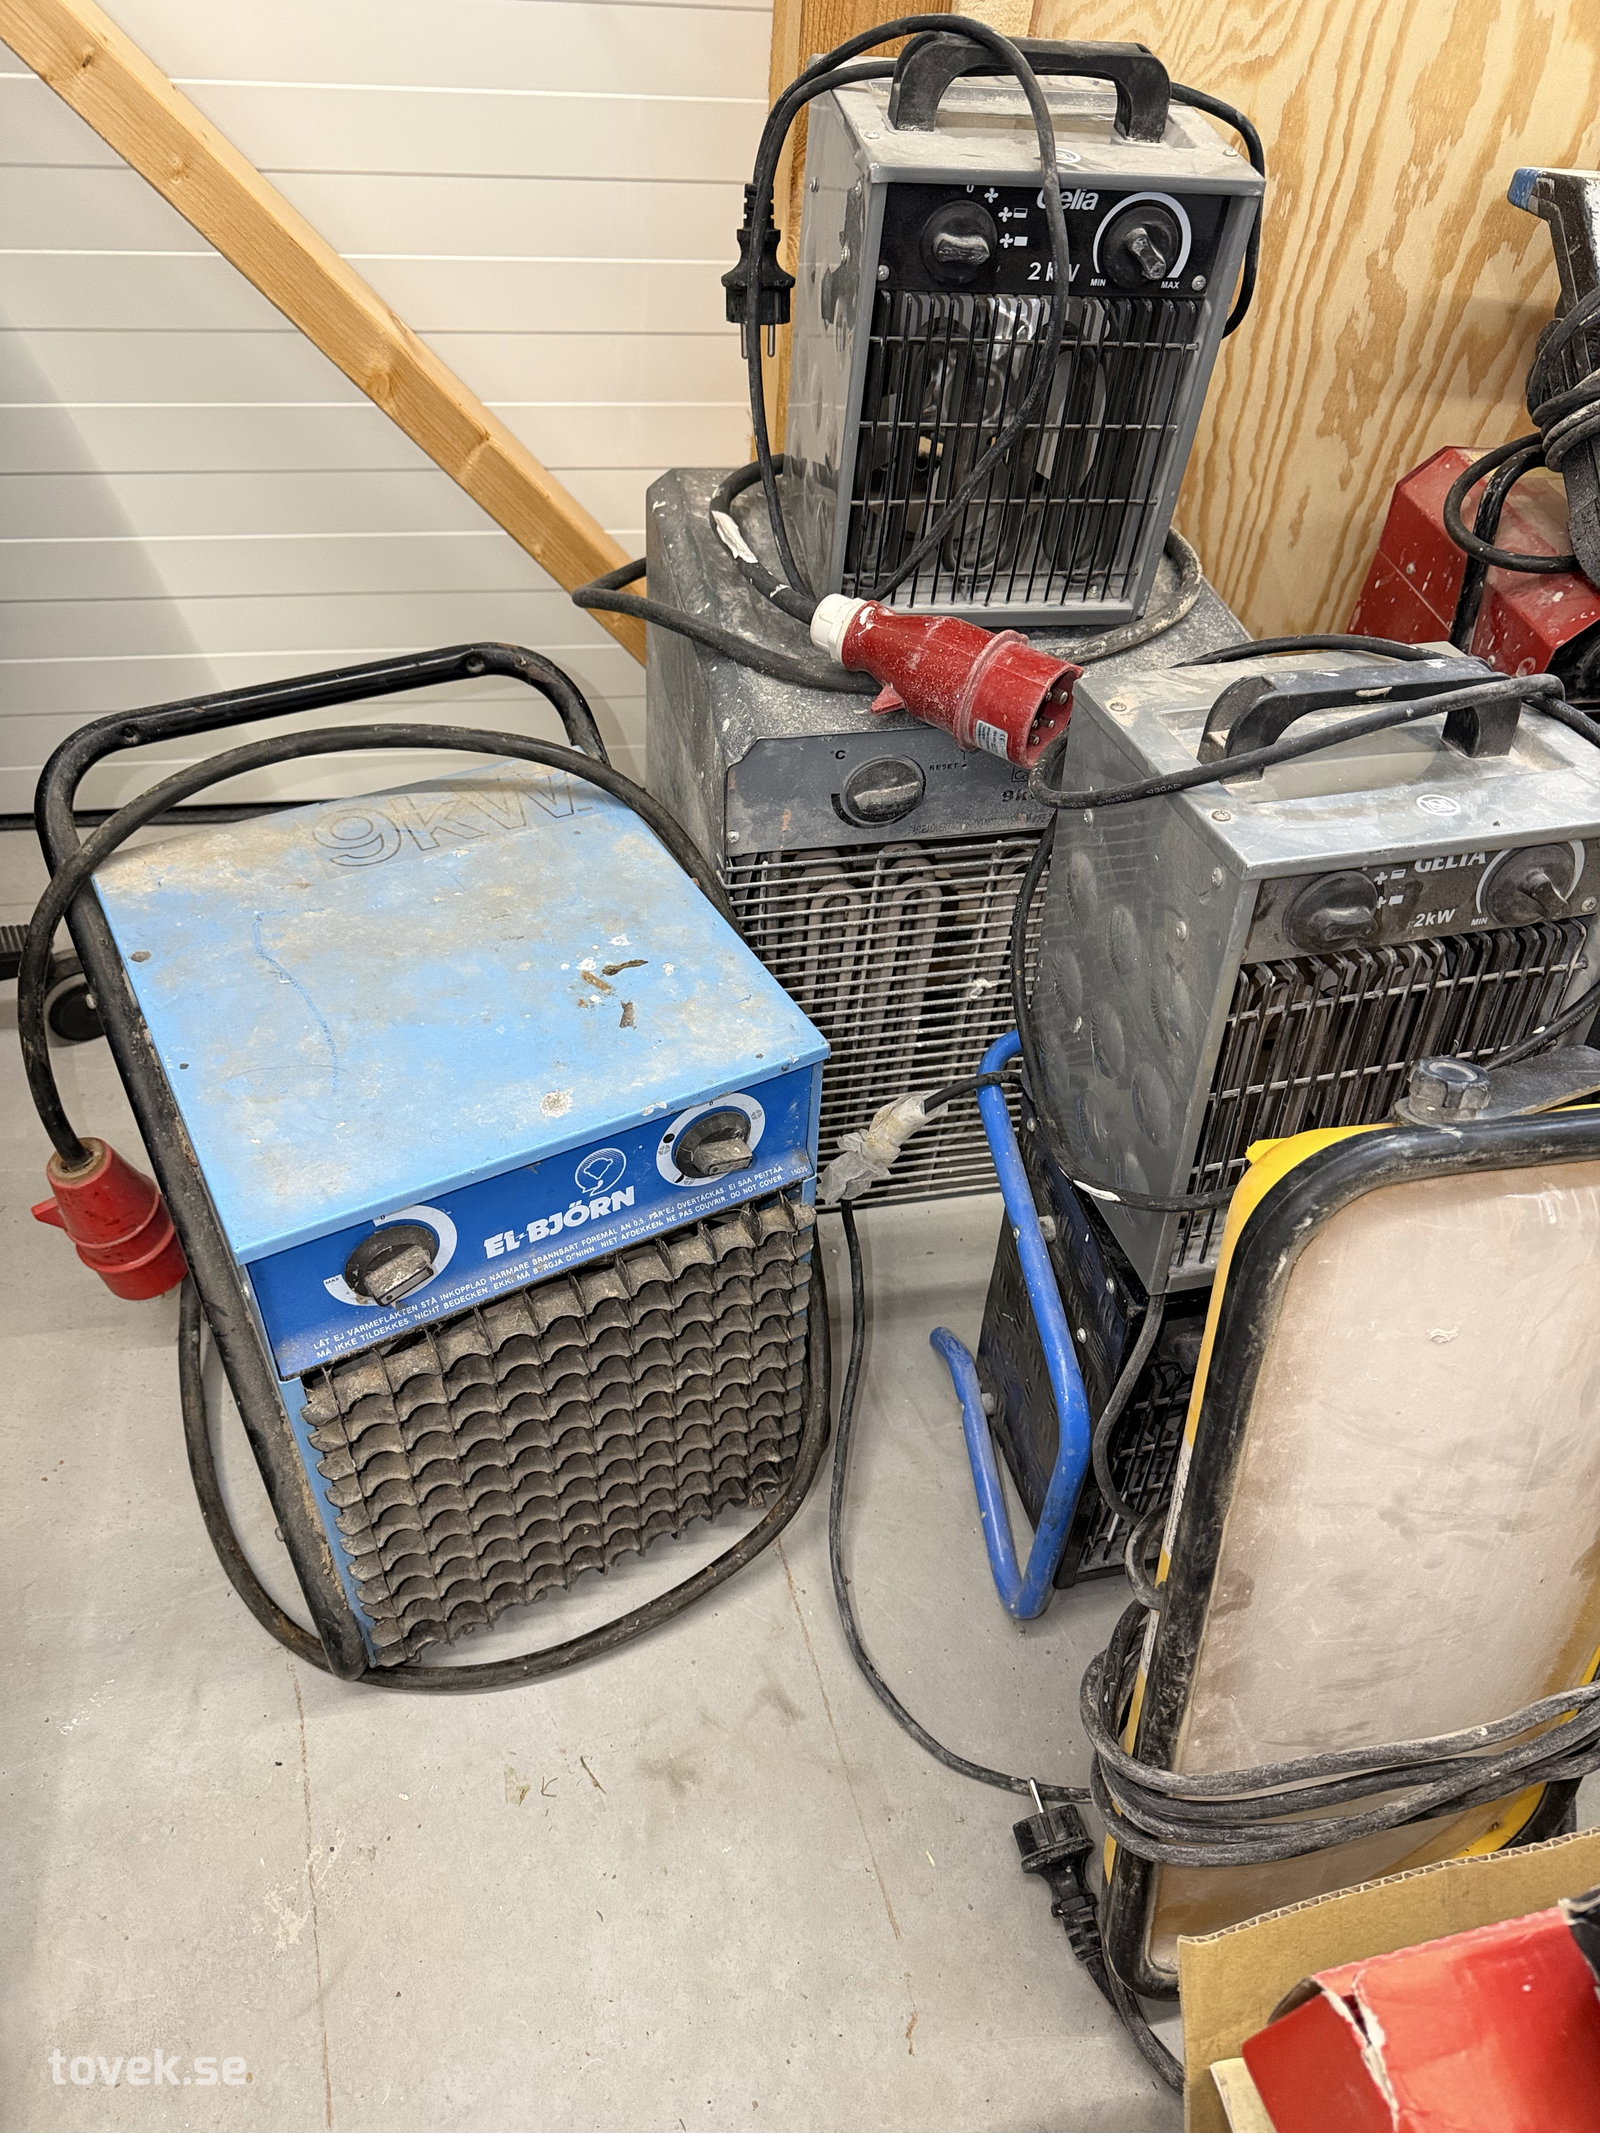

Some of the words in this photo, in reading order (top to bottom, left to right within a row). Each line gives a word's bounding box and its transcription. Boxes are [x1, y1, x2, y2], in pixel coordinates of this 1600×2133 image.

[1027, 261, 1042, 281] 2
[1090, 278, 1107, 287] MIN
[1160, 280, 1180, 290] MAX
[929, 762, 959, 771] RESET
[312, 772, 575, 867] 9kW
[1413, 908, 1457, 928] 2kW
[1471, 916, 1489, 927] MIN
[333, 1332, 345, 1342] EJ
[440, 1278, 487, 1301] INKOPPLAD
[729, 1182, 736, 1191] EI
[335, 1338, 358, 1352] IKKE
[414, 1304, 440, 1321] NICHT
[600, 1237, 619, 1249] NIET
[667, 1213, 677, 1224] NE
[679, 1208, 693, 1219] PAS
[730, 1190, 741, 1200] DO
[743, 1184, 757, 1194] NOT
[325, 1277, 339, 1285] MAX
